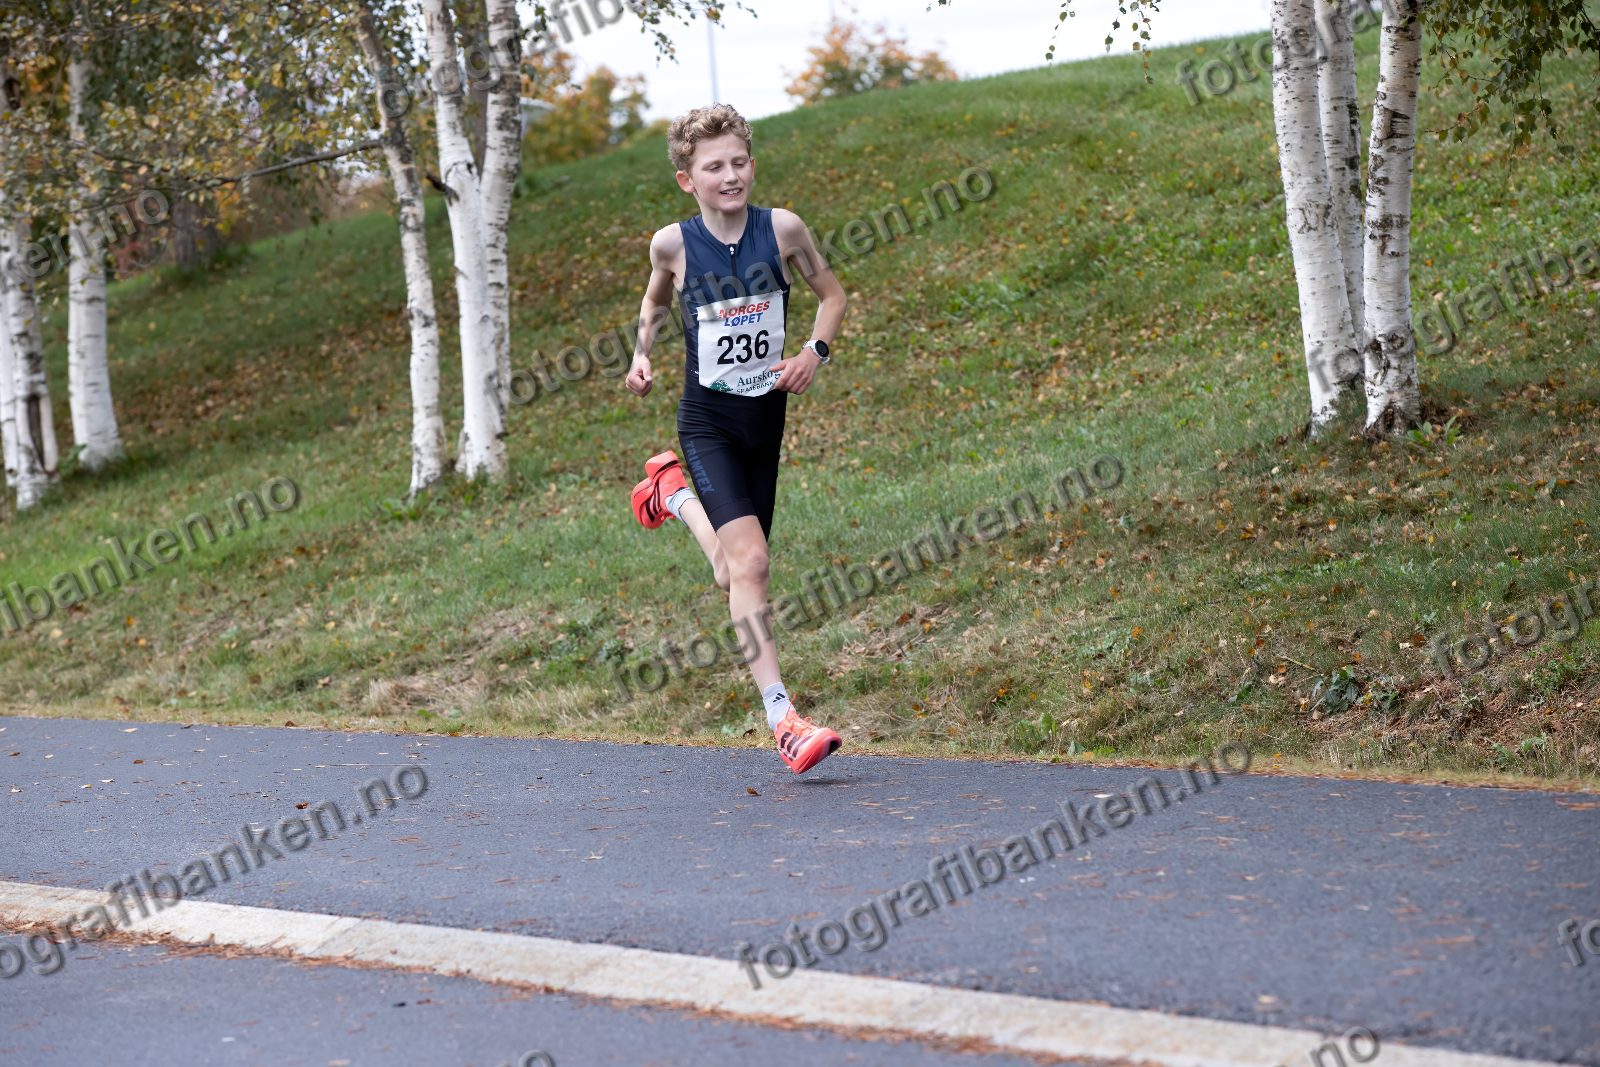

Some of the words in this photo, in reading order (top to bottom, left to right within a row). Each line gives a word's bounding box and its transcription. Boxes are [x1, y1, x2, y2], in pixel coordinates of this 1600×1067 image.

[719, 300, 771, 319] NORGES
[724, 312, 763, 327] LØPET
[717, 329, 770, 365] 236
